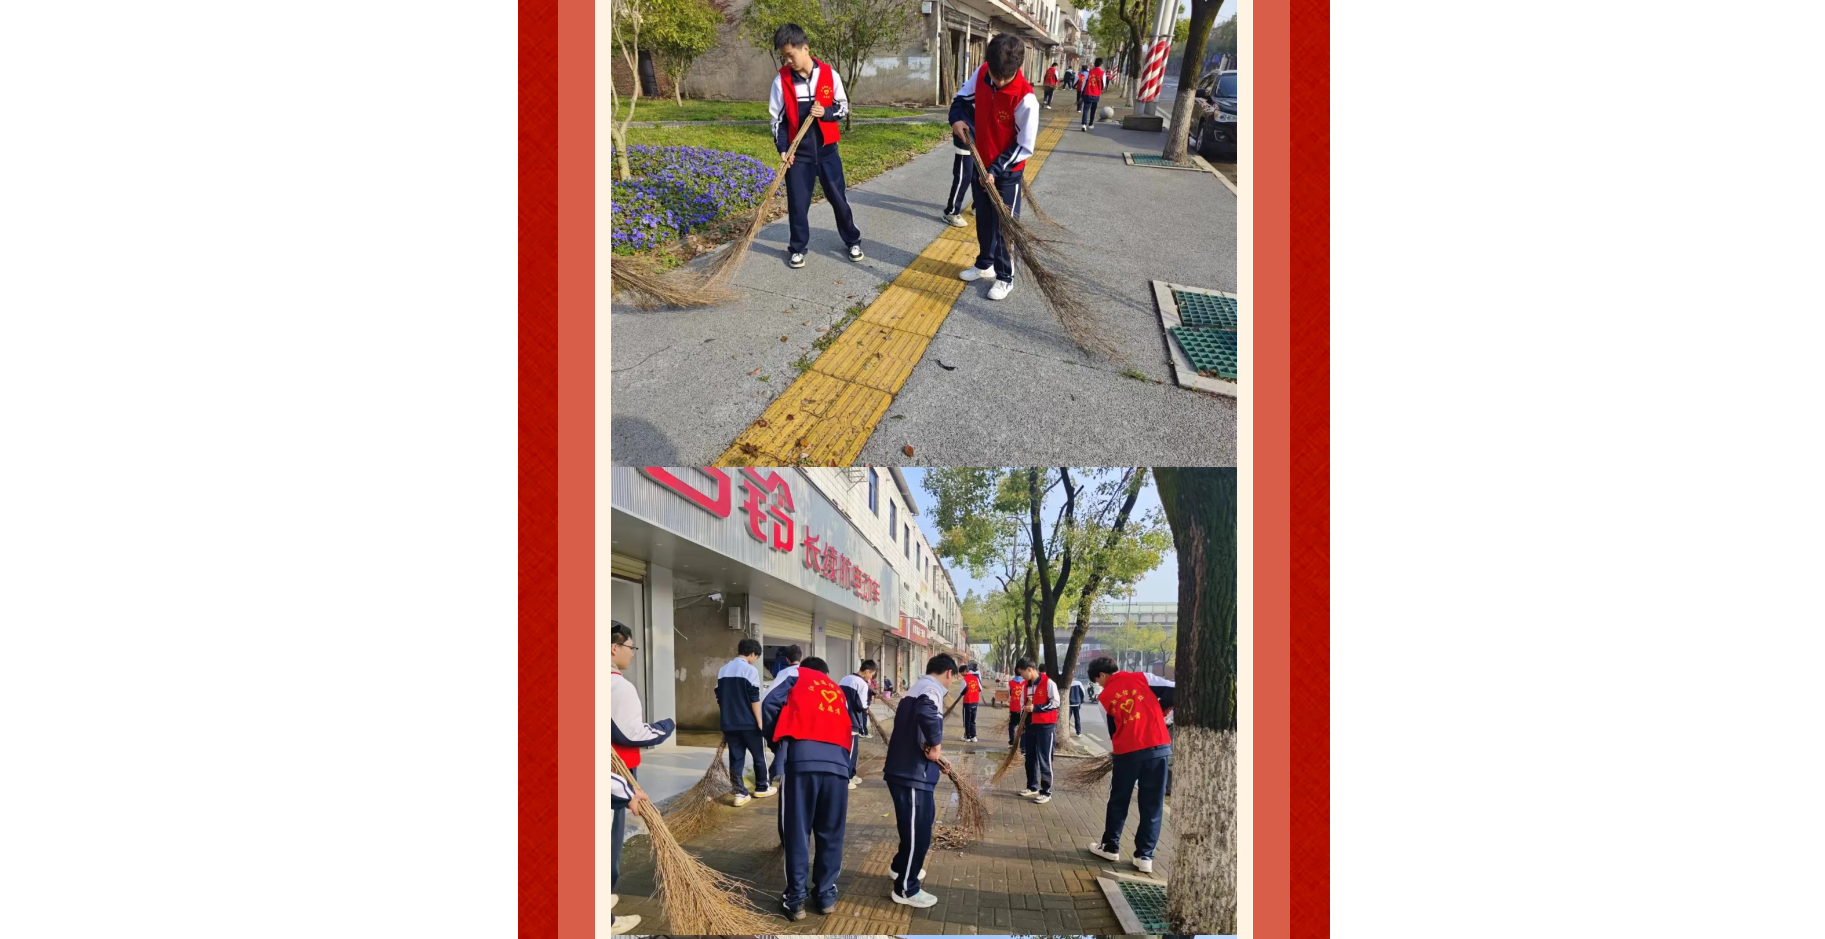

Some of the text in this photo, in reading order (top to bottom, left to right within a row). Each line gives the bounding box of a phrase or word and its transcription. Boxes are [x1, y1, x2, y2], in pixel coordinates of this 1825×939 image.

[803, 525, 880, 605] 长续航电动车
